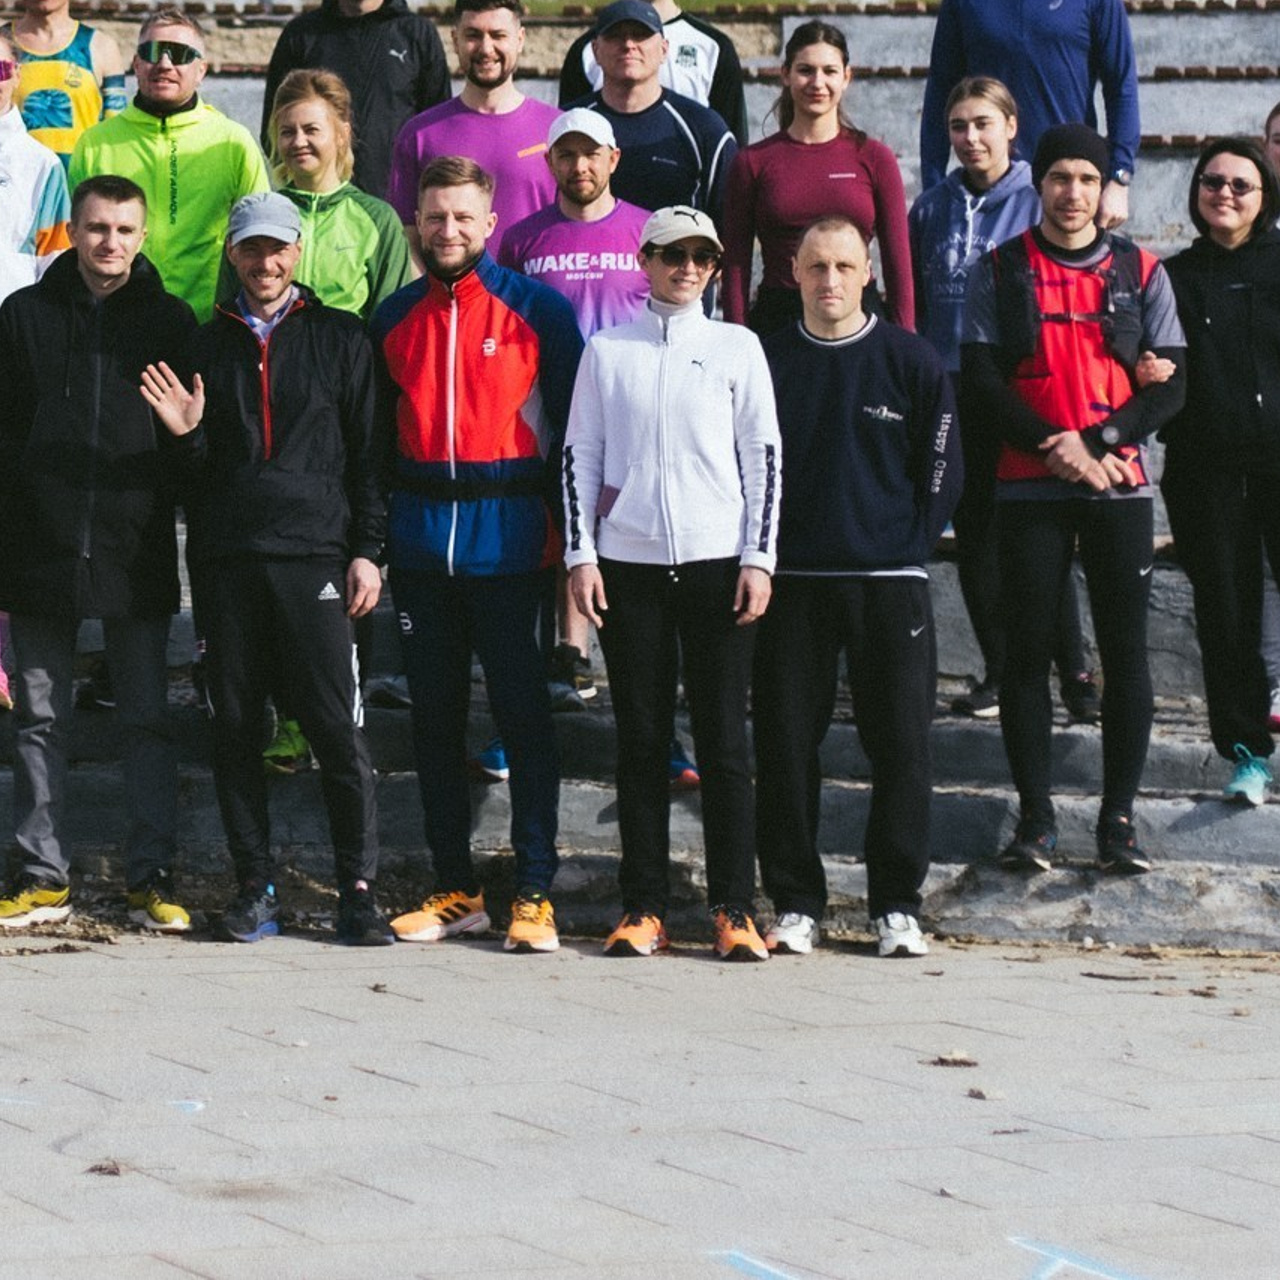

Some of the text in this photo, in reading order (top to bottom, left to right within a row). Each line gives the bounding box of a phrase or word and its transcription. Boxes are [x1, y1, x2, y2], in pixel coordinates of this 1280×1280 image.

[565, 272, 604, 280] MOSCOW
[930, 413, 952, 494] Happy Ones
